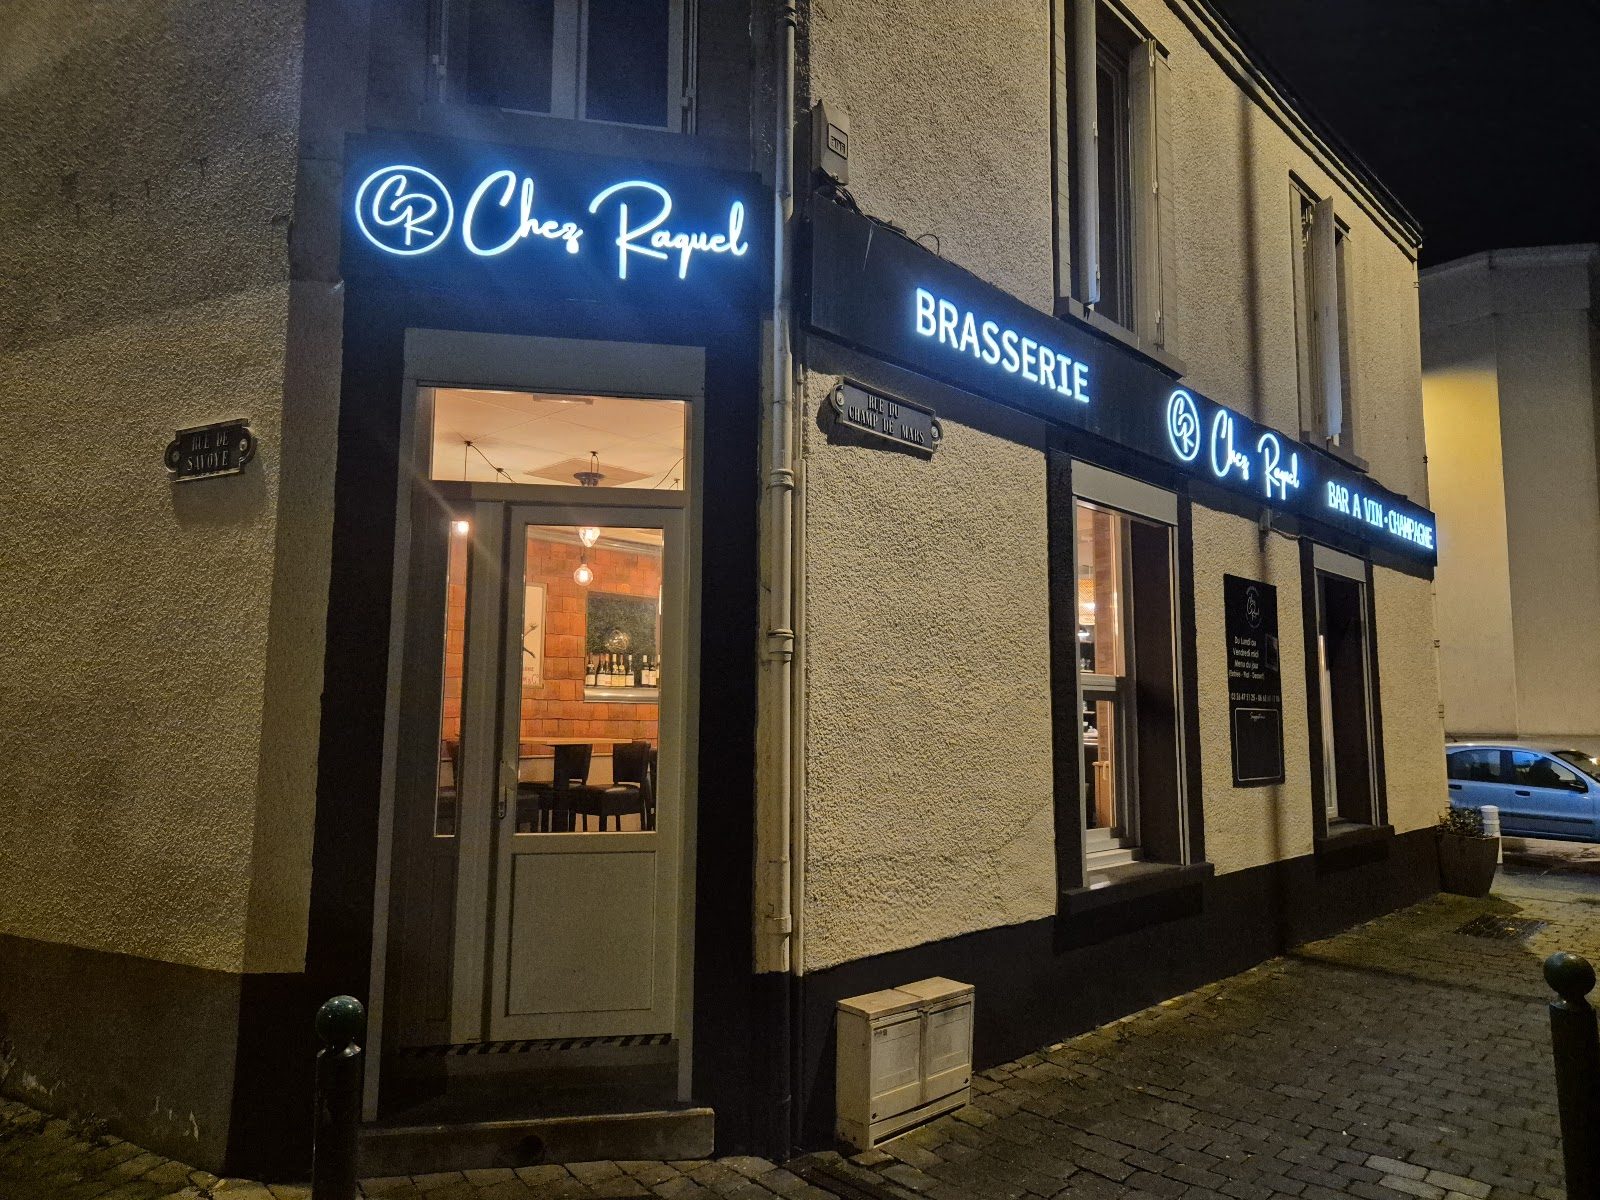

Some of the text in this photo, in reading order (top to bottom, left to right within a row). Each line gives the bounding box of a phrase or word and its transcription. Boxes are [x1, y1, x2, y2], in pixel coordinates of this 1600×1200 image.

[462, 169, 584, 256] Chez
[588, 180, 749, 280] Raquel
[916, 287, 1090, 404] BRASSERIE
[191, 431, 229, 452] RUE DE
[848, 405, 925, 445] CHAMP DE MARS
[868, 394, 900, 419] RUE DU
[1211, 409, 1250, 481] Chez
[1258, 432, 1300, 501] Raquel
[1327, 480, 1350, 514] BAR
[1352, 492, 1362, 520] A
[1363, 497, 1384, 528] VIN
[1388, 509, 1434, 550] CHAMPAGNE
